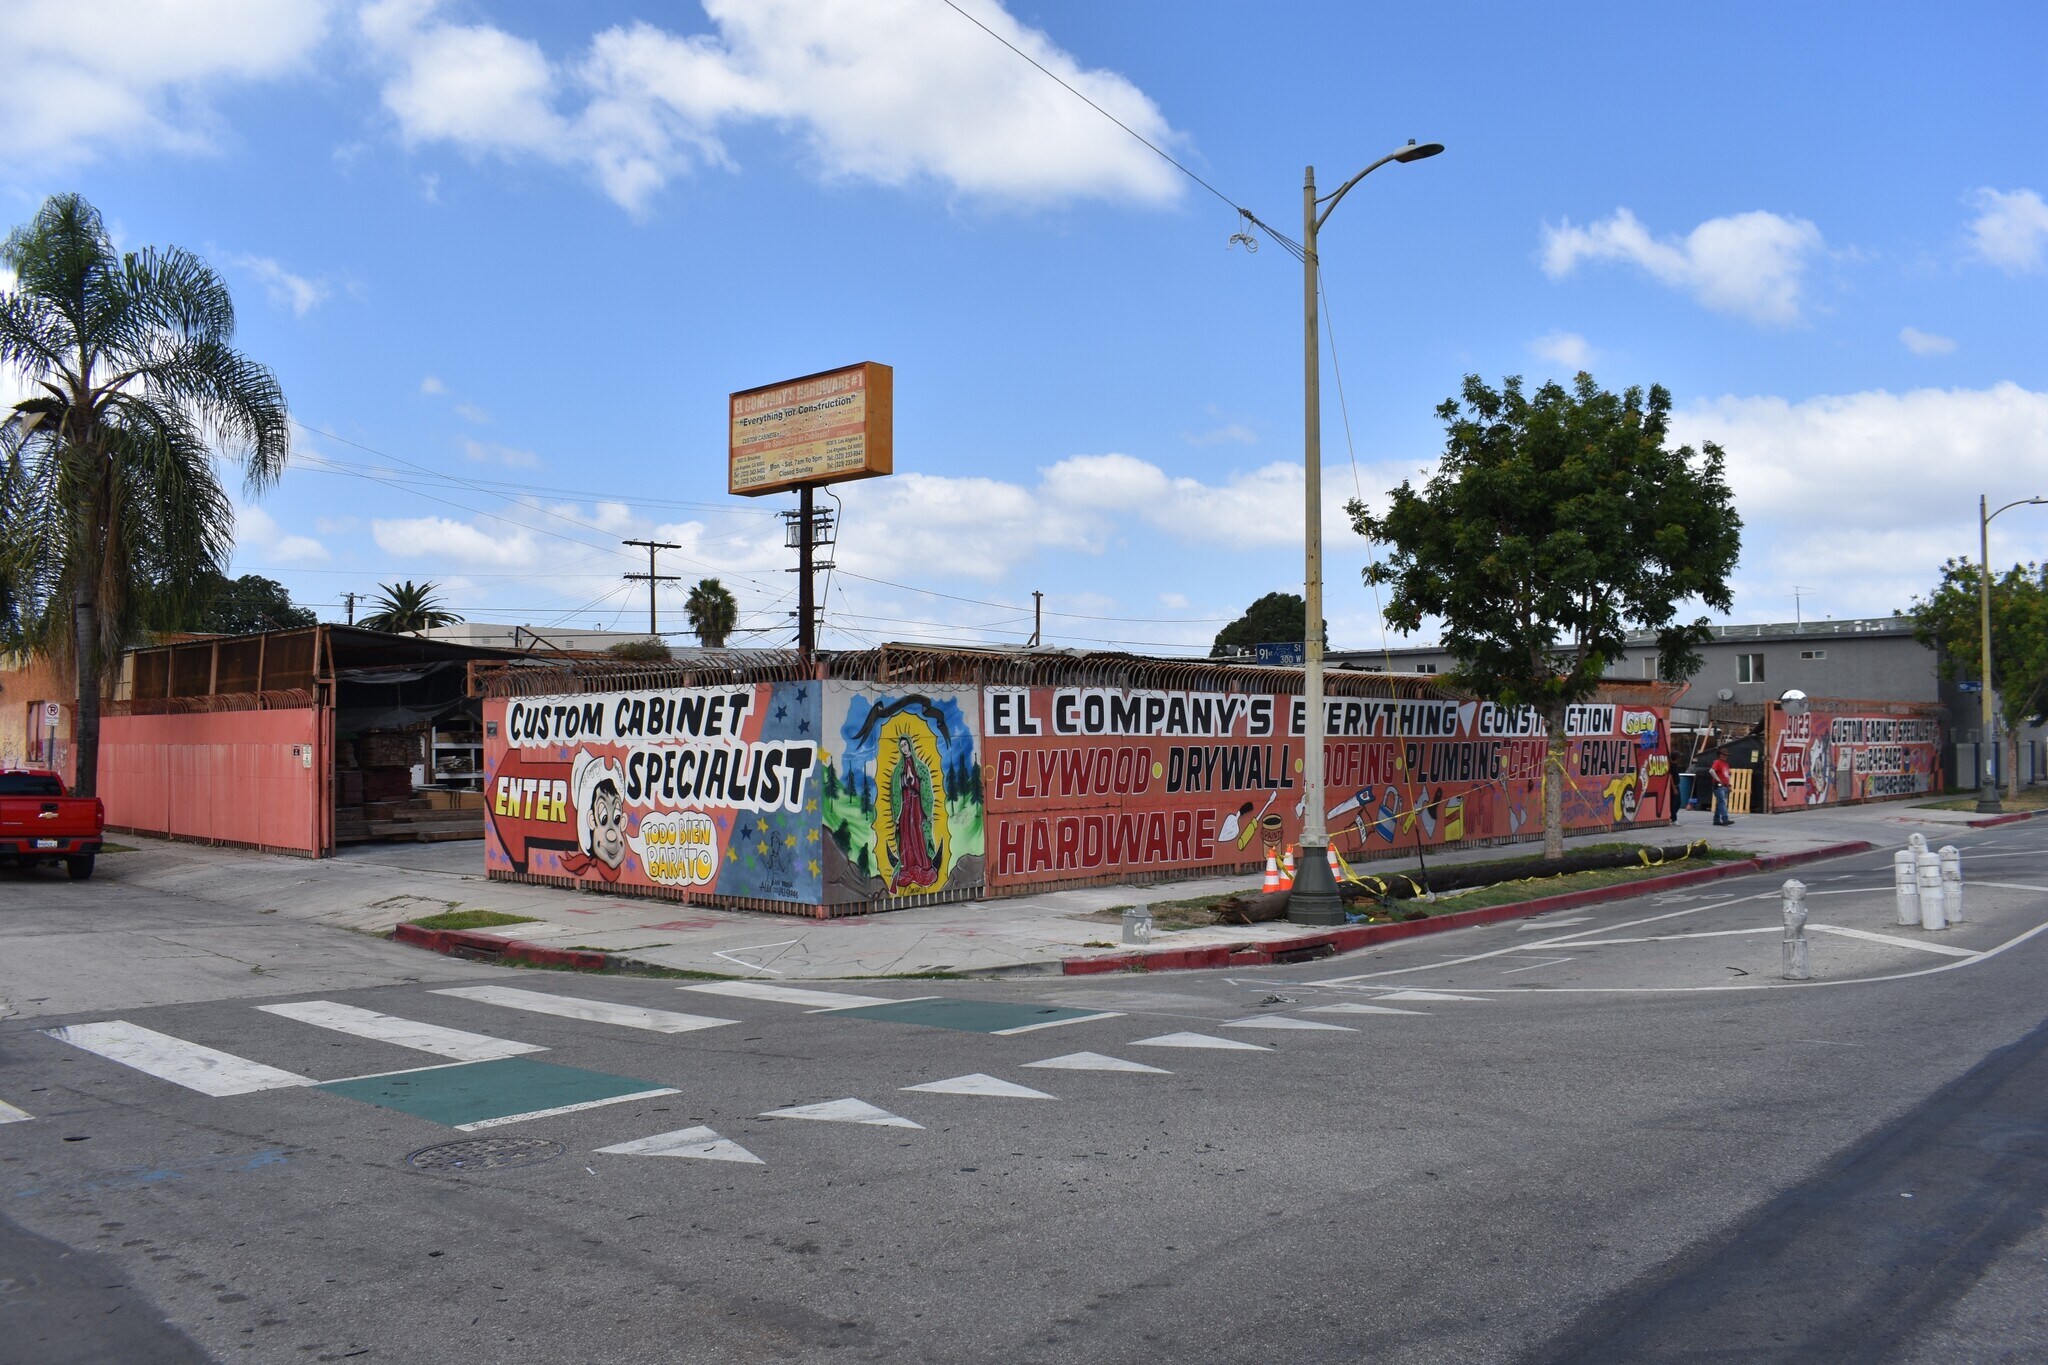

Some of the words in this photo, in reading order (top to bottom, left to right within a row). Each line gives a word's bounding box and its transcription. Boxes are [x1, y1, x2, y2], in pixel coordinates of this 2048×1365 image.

[735, 401, 743, 414] EL
[745, 387, 795, 410] COMPANY'S
[851, 371, 863, 387] #1
[785, 408, 796, 417] for
[778, 468, 795, 477] Closed
[796, 464, 813, 475] Sunday
[1280, 655, 1293, 664] 300
[1295, 655, 1302, 663] W
[1294, 644, 1301, 652] St
[510, 702, 605, 741] CUSTOM
[614, 694, 750, 738] CABINET
[993, 694, 1037, 735] EL
[1055, 694, 1271, 735] COMPANY'S
[1292, 701, 1456, 736] EERYTHING
[1480, 704, 1613, 734] CONSTCTION
[1626, 712, 1653, 734] SOLO
[1787, 714, 1810, 739] 9023
[1831, 719, 1863, 743] CUSTOM
[1866, 719, 1896, 742] CABINET
[1898, 720, 1934, 742] SPECIALIST
[995, 747, 1152, 800] PLYWOOD
[1165, 744, 1294, 793] DRYWALL
[1304, 743, 1395, 788] OOFING
[1403, 740, 1500, 784] PLUMBING
[1508, 740, 1574, 780] CEMT
[1580, 739, 1636, 776] GRAVEL
[1781, 752, 1800, 772] EXIT
[626, 747, 813, 805] SPECIALIST
[494, 775, 568, 824] ENTER
[641, 821, 676, 846] TODO
[679, 818, 711, 846] BIEN
[998, 809, 1217, 876] HARDWARE
[1264, 829, 1282, 840] PAINT
[646, 846, 713, 880] BARATO
